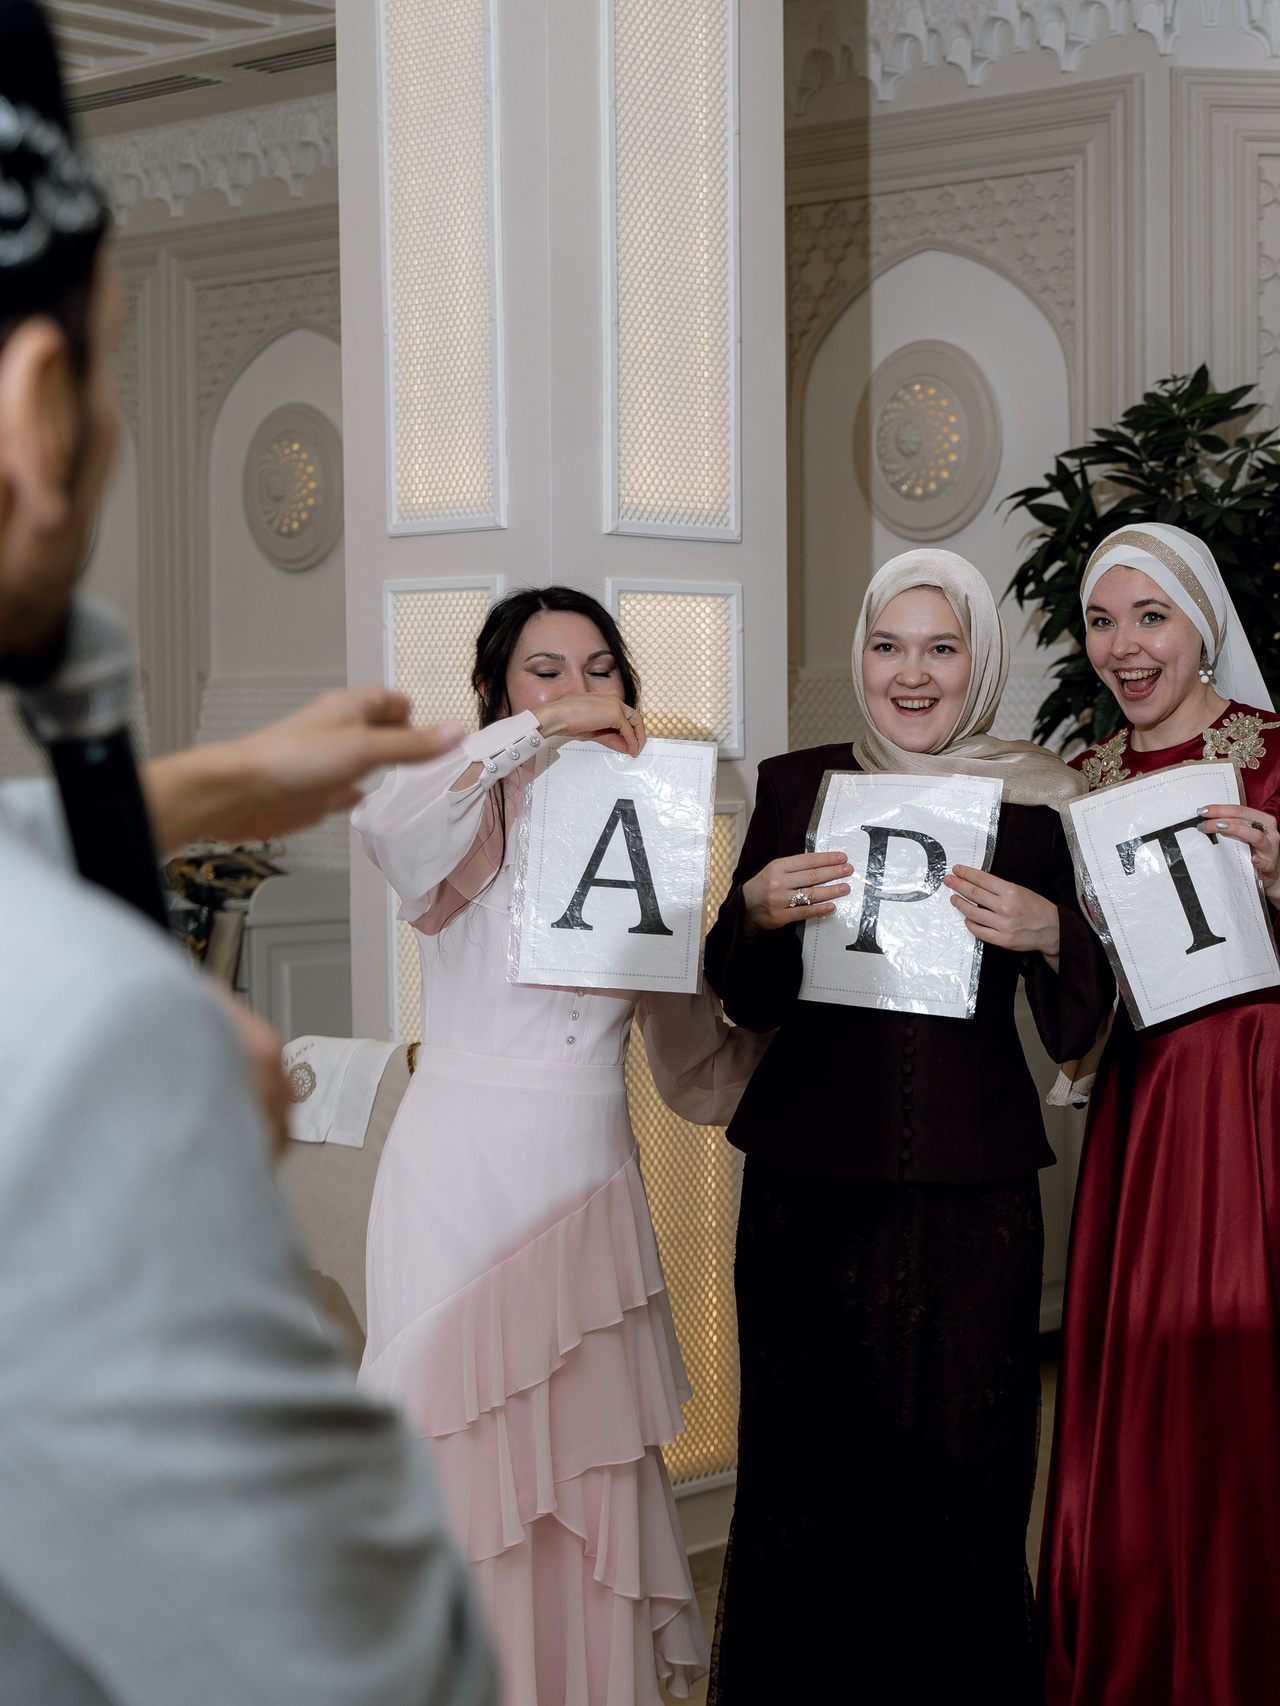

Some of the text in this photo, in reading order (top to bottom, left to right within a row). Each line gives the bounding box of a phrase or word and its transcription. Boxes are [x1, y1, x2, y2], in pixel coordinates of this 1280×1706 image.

[550, 798, 674, 936] А
[844, 824, 948, 954] Р
[1116, 816, 1227, 956] Т
